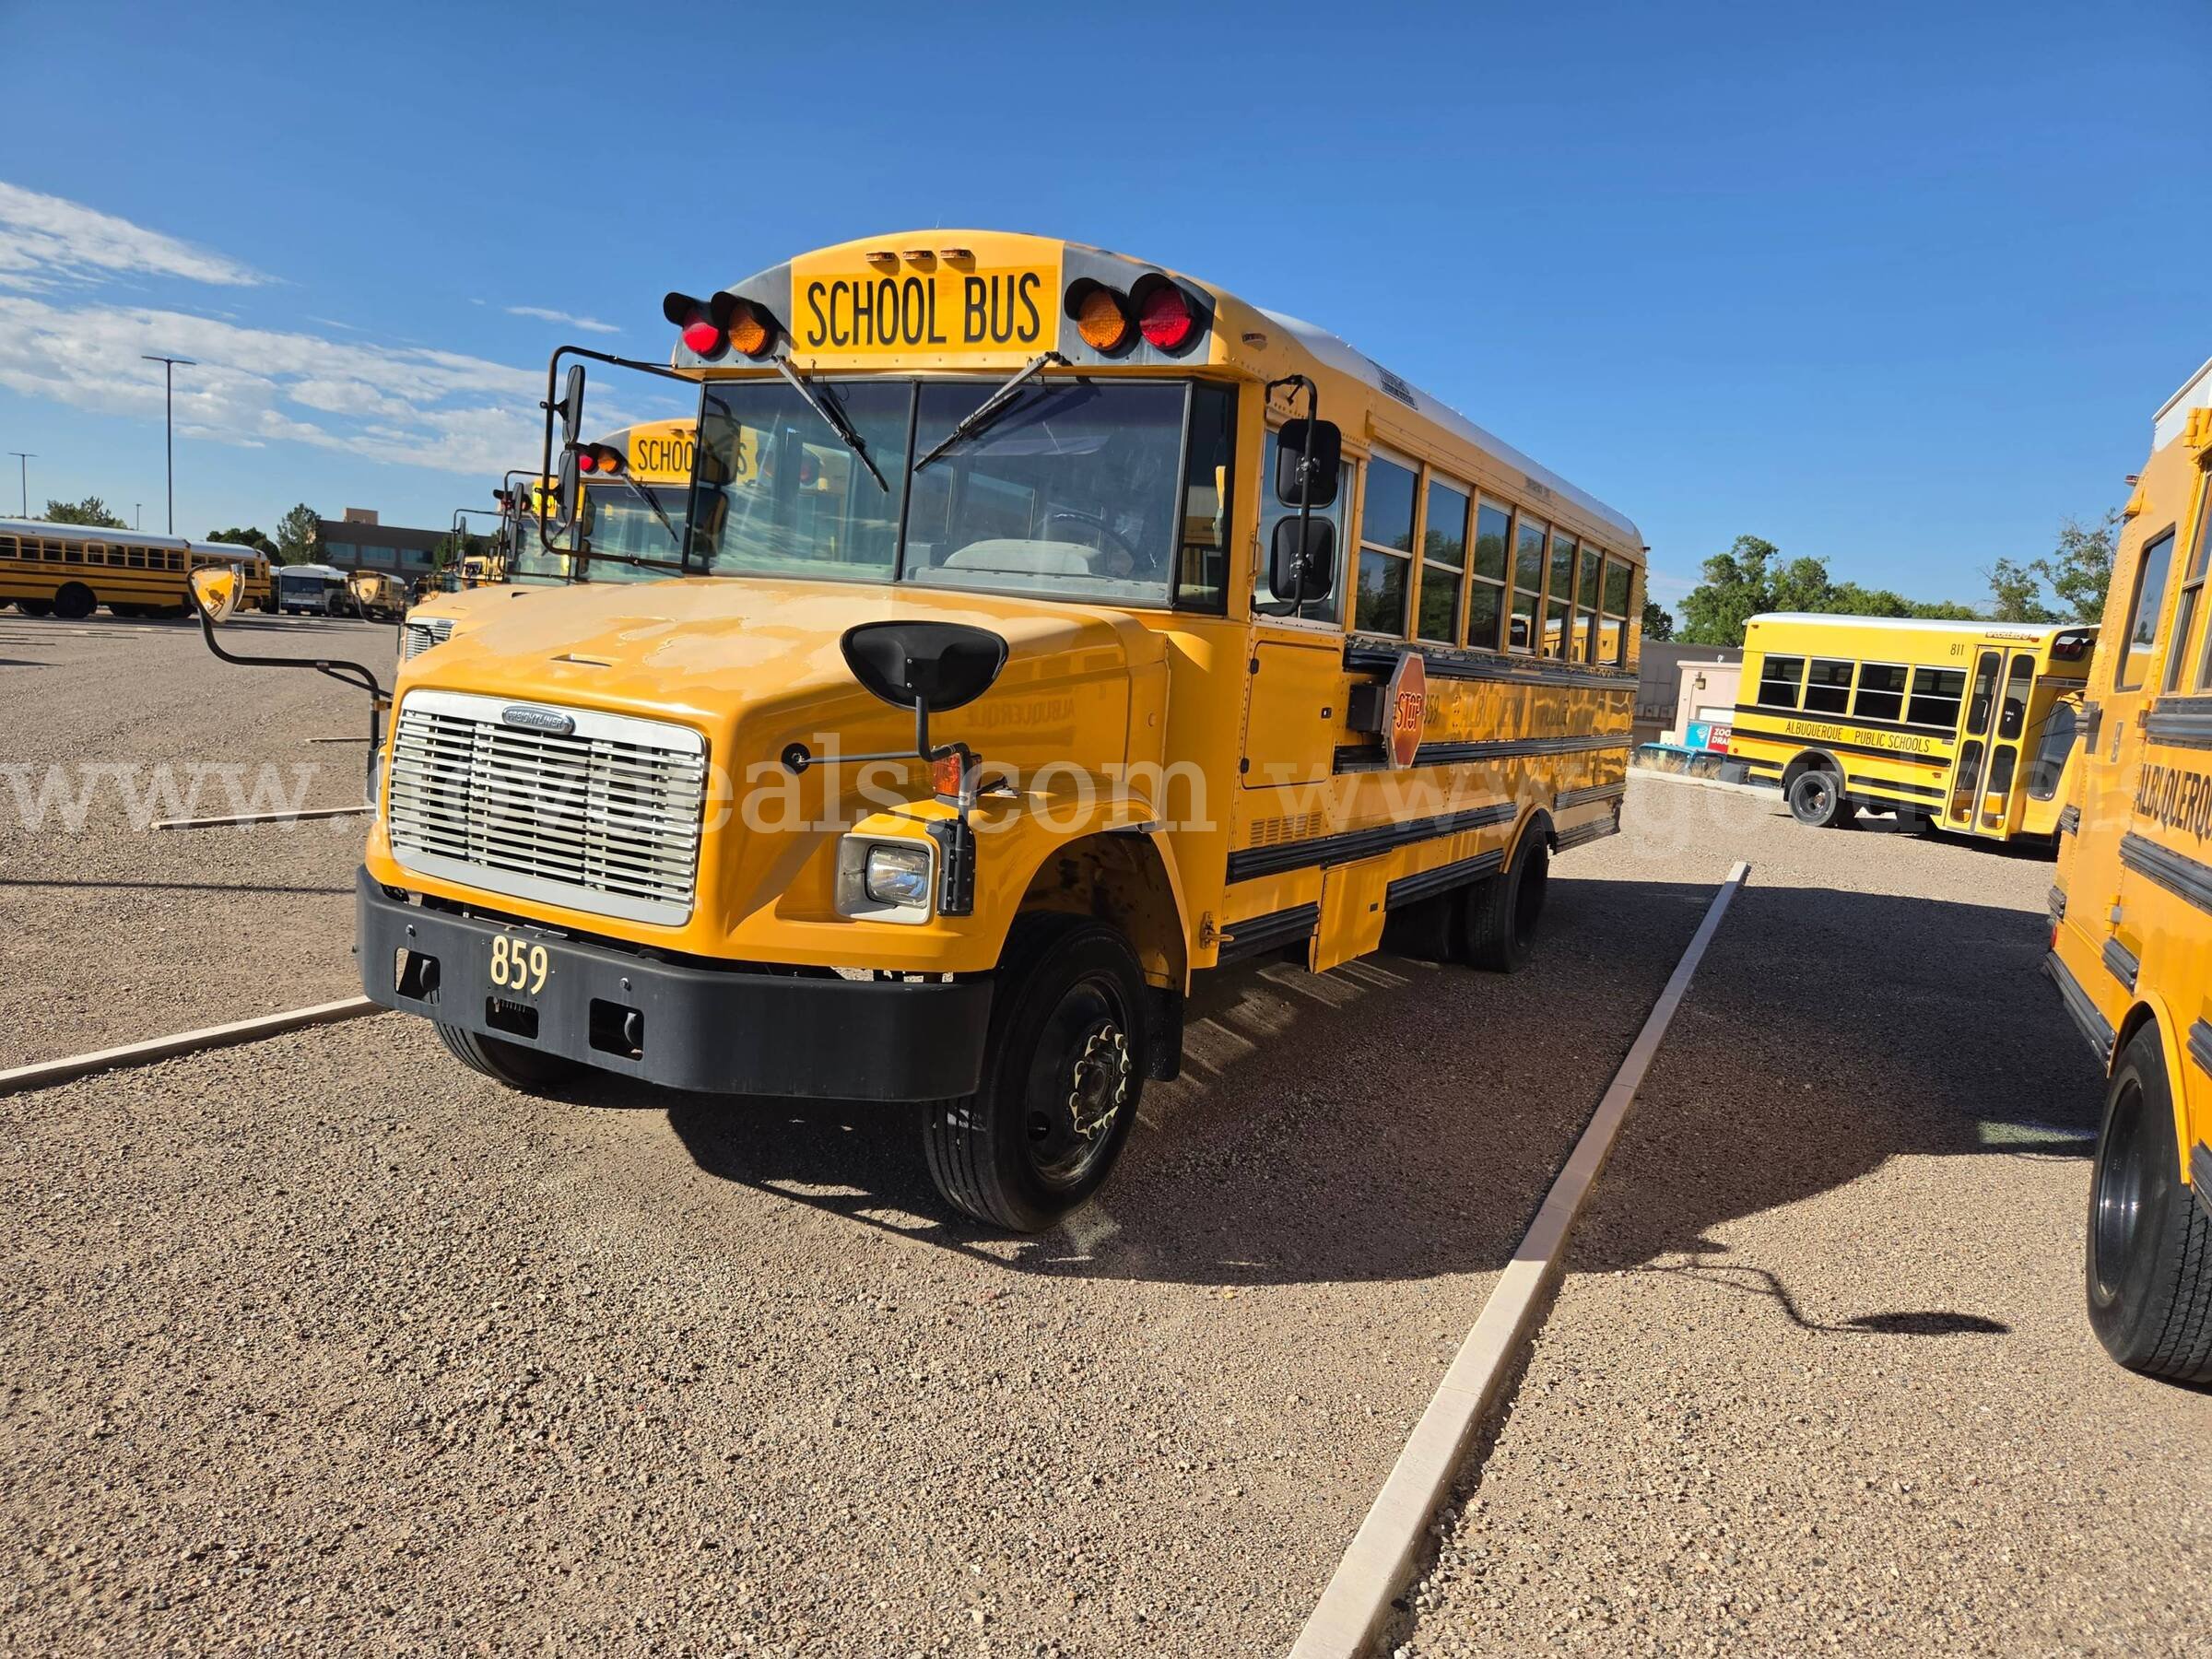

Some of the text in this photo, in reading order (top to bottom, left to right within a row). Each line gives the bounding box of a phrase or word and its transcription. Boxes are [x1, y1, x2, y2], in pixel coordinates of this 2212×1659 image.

[806, 272, 1041, 347] SCHOOL BUS
[638, 439, 694, 473] SCHOO
[1949, 643, 1965, 656] 811
[506, 712, 563, 729] FREIGHTLINER
[1396, 691, 1423, 732] STOP
[1785, 722, 1931, 753] ALBUQUERQUE PUBLIC SCHOOLS
[490, 935, 548, 995] 859
